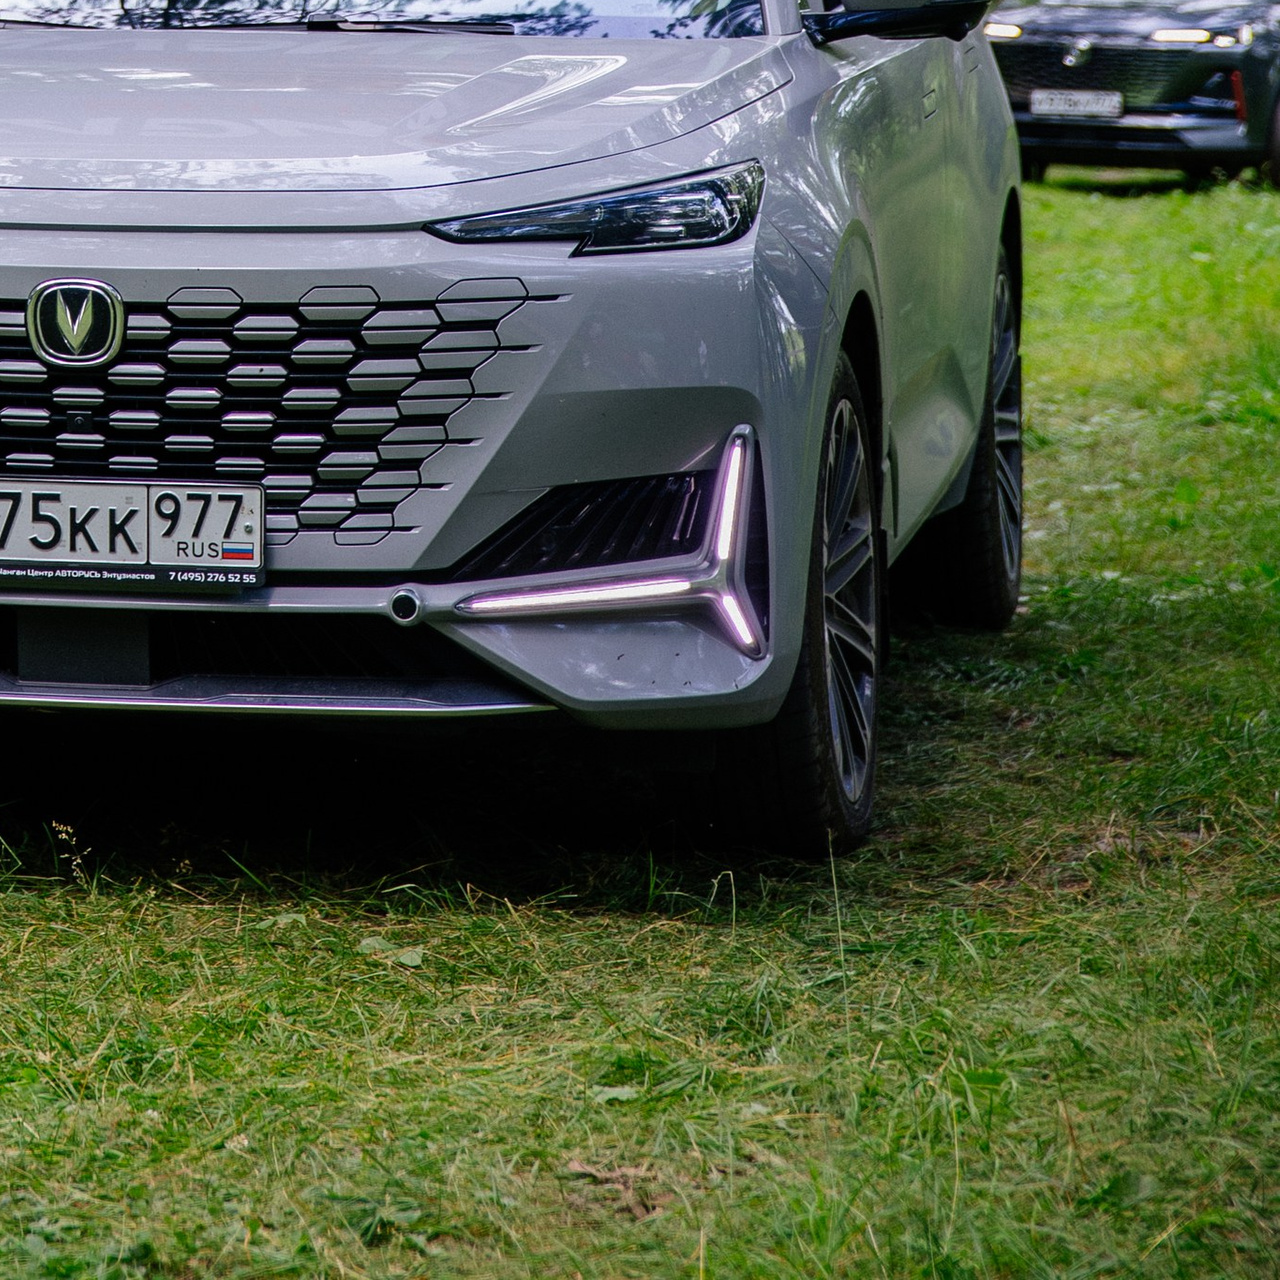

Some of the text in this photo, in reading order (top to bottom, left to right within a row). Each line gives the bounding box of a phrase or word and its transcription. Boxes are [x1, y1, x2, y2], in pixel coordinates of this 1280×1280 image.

[154, 492, 244, 539] 977
[176, 541, 219, 558] RUS
[27, 569, 53, 577] Центр
[55, 570, 101, 578] АВТОРУСЬ
[102, 571, 155, 580] Энтузиастов
[169, 572, 256, 583] 7 (495) 276 52 55
